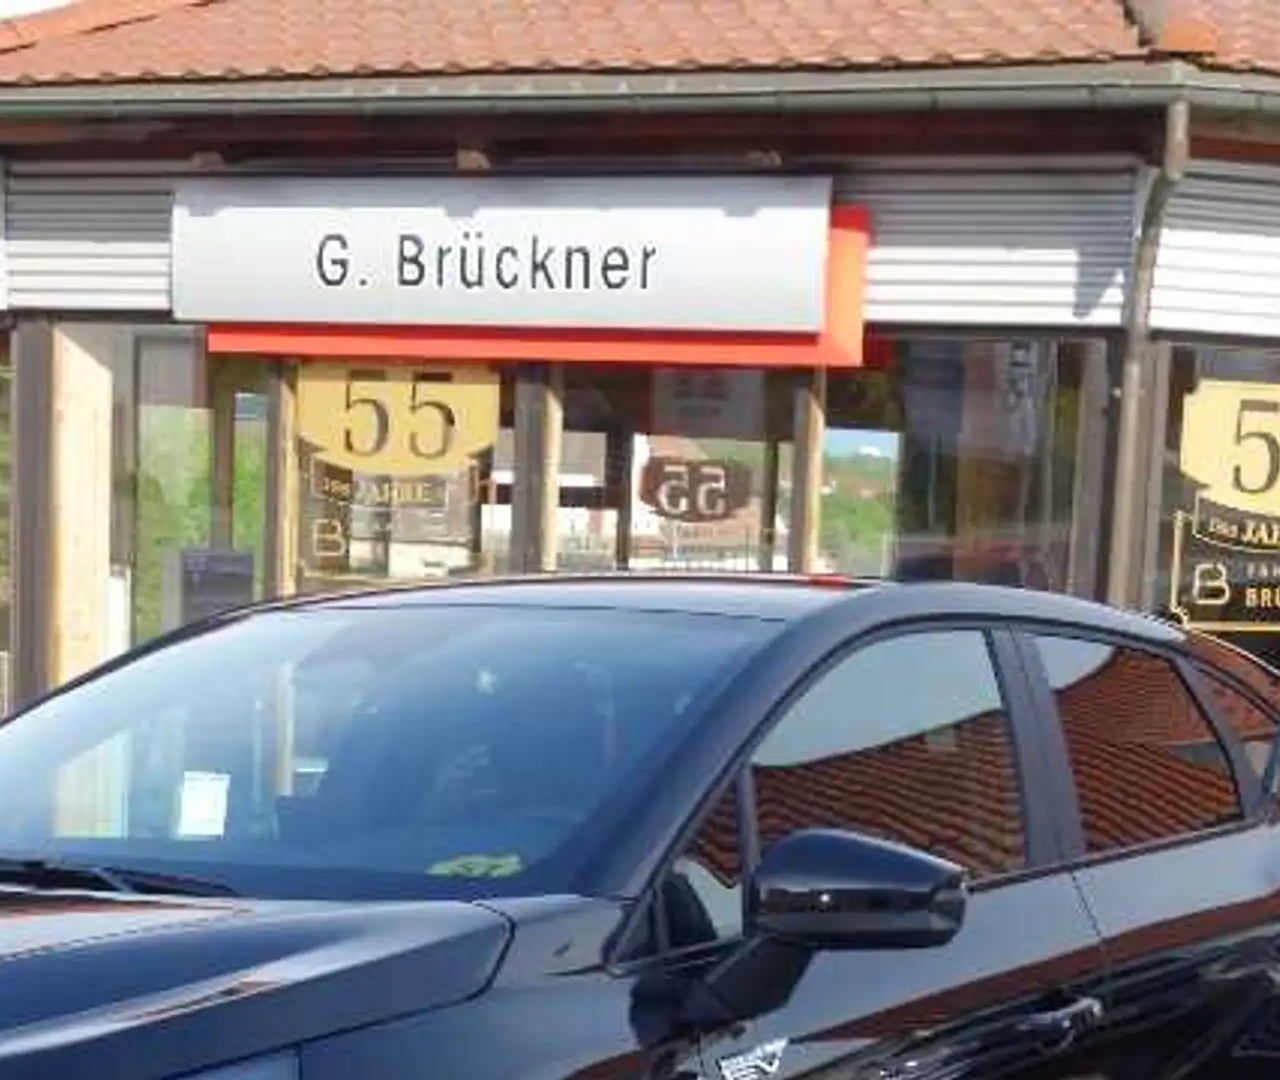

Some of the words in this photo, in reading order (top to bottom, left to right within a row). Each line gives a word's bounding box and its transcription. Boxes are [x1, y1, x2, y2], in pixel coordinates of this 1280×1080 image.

[317, 233, 368, 286] G.
[398, 231, 656, 289] Brückner
[345, 370, 456, 459] 55
